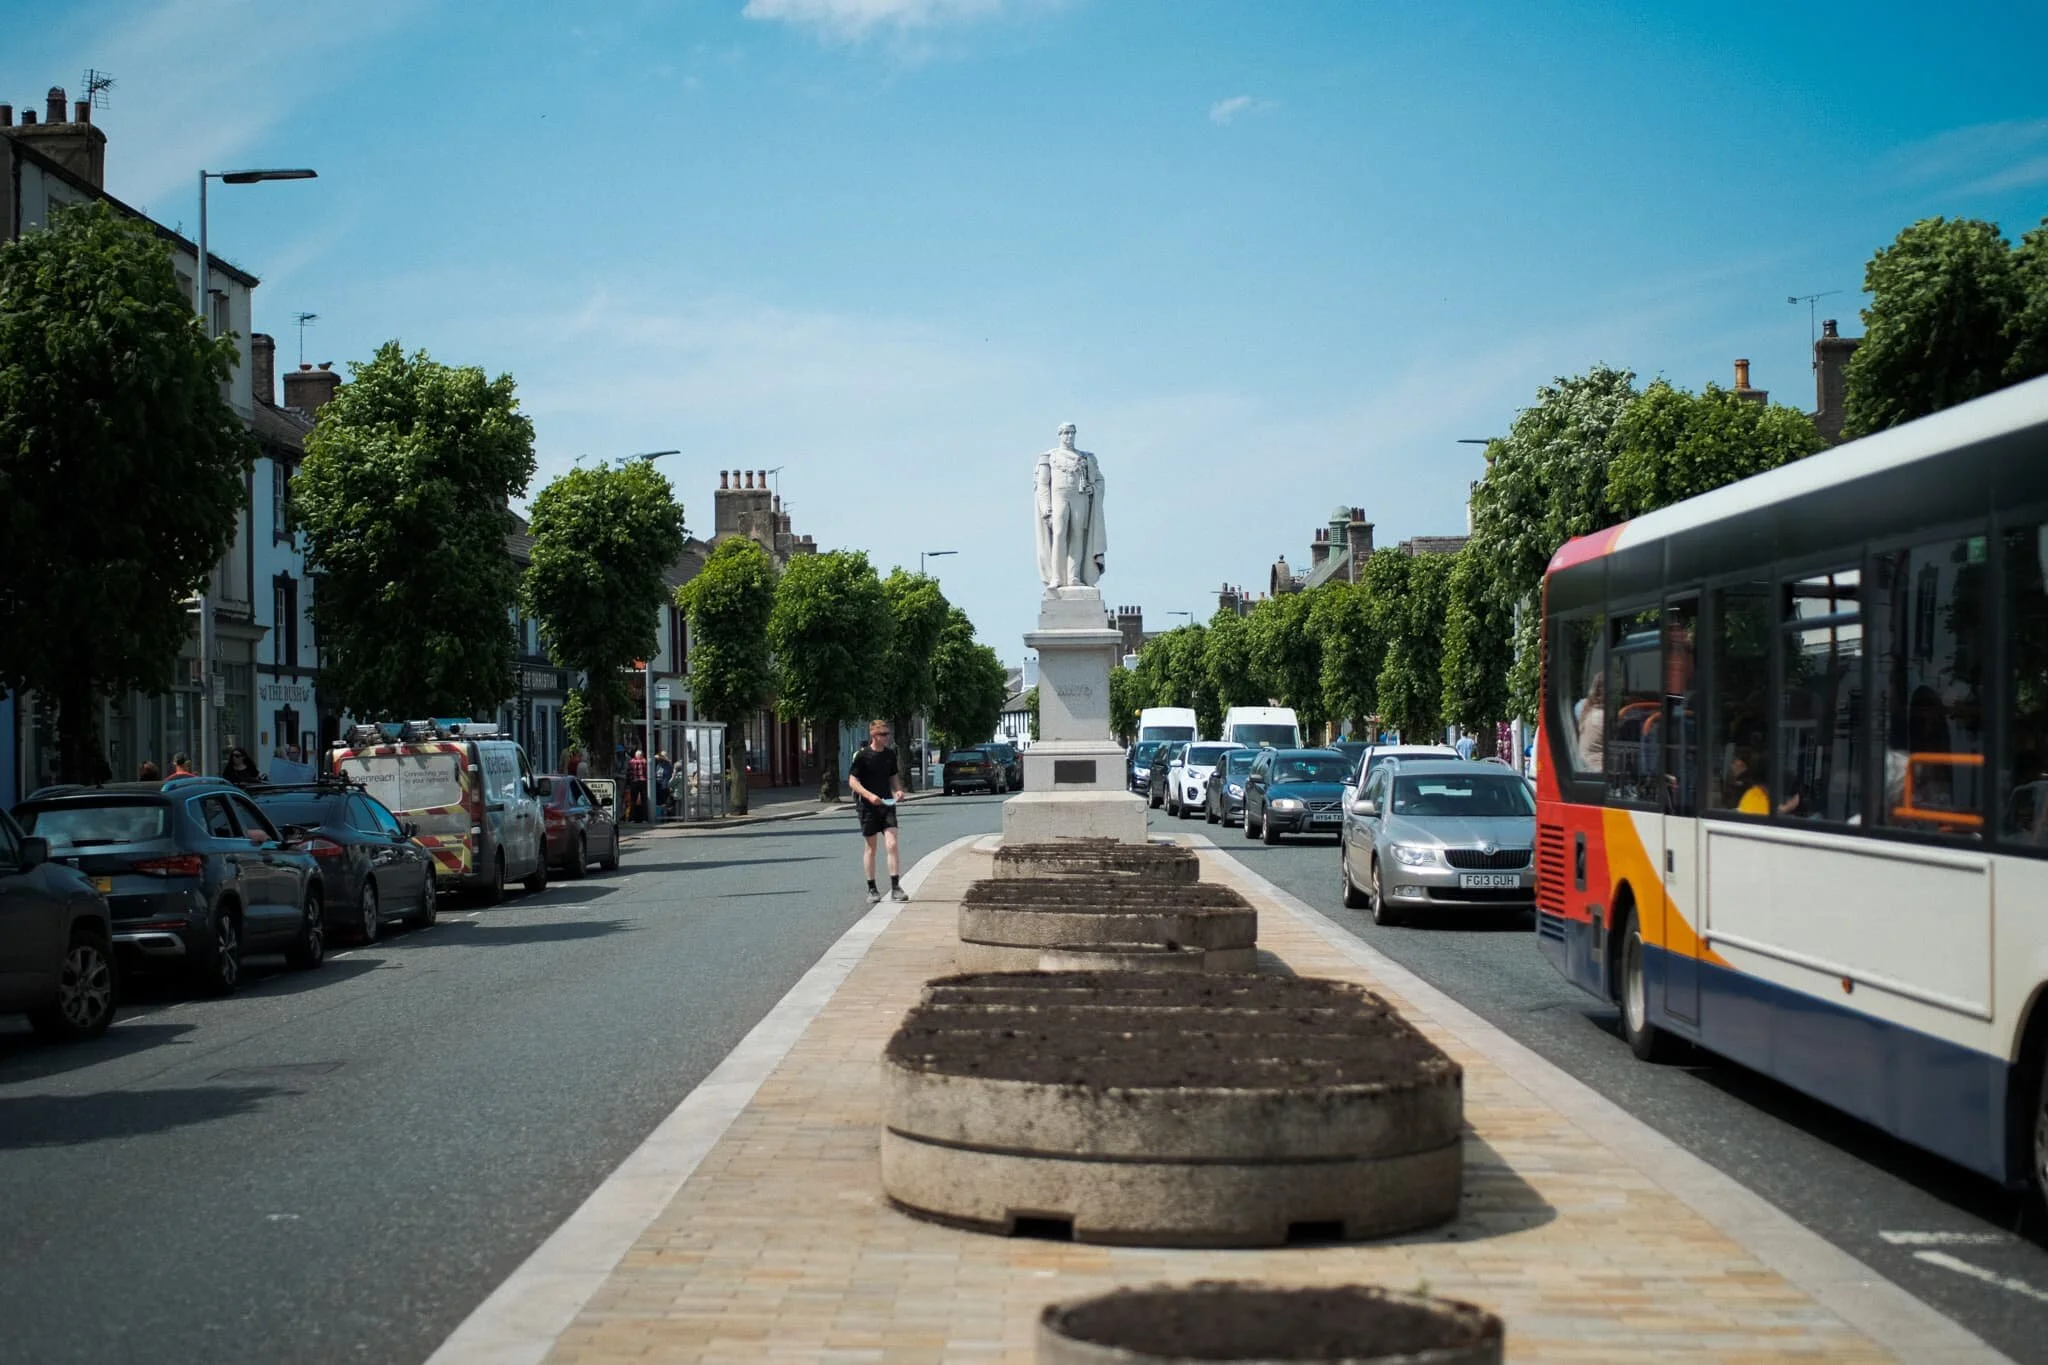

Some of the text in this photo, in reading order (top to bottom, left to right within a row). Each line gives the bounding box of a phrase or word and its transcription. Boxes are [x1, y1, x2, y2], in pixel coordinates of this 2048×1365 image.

[268, 685, 302, 702] THE BUSH
[1466, 875, 1514, 886] FG13 GUH
